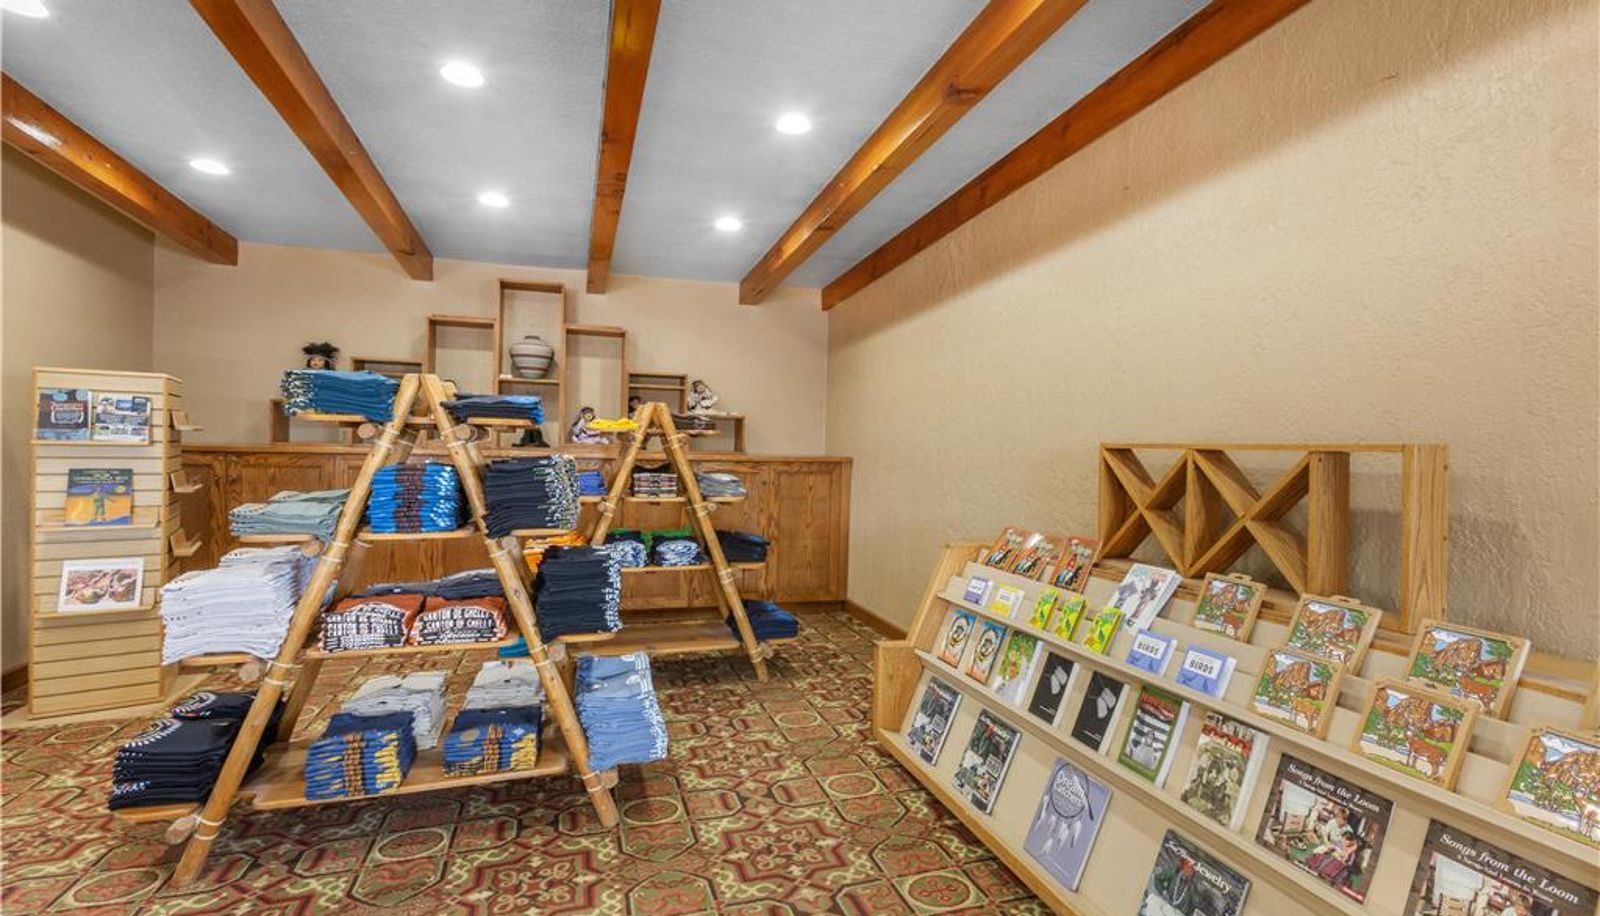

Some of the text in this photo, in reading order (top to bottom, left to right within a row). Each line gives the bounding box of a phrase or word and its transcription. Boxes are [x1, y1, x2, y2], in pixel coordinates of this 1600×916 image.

[1189, 659, 1214, 675] BIRDS
[1286, 763, 1313, 782] Songs
[1313, 776, 1335, 792] from
[1336, 787, 1353, 799] the
[1353, 794, 1381, 813] Loom
[1193, 861, 1232, 894] Jewelry
[1439, 834, 1580, 905] Songs from the Loom
